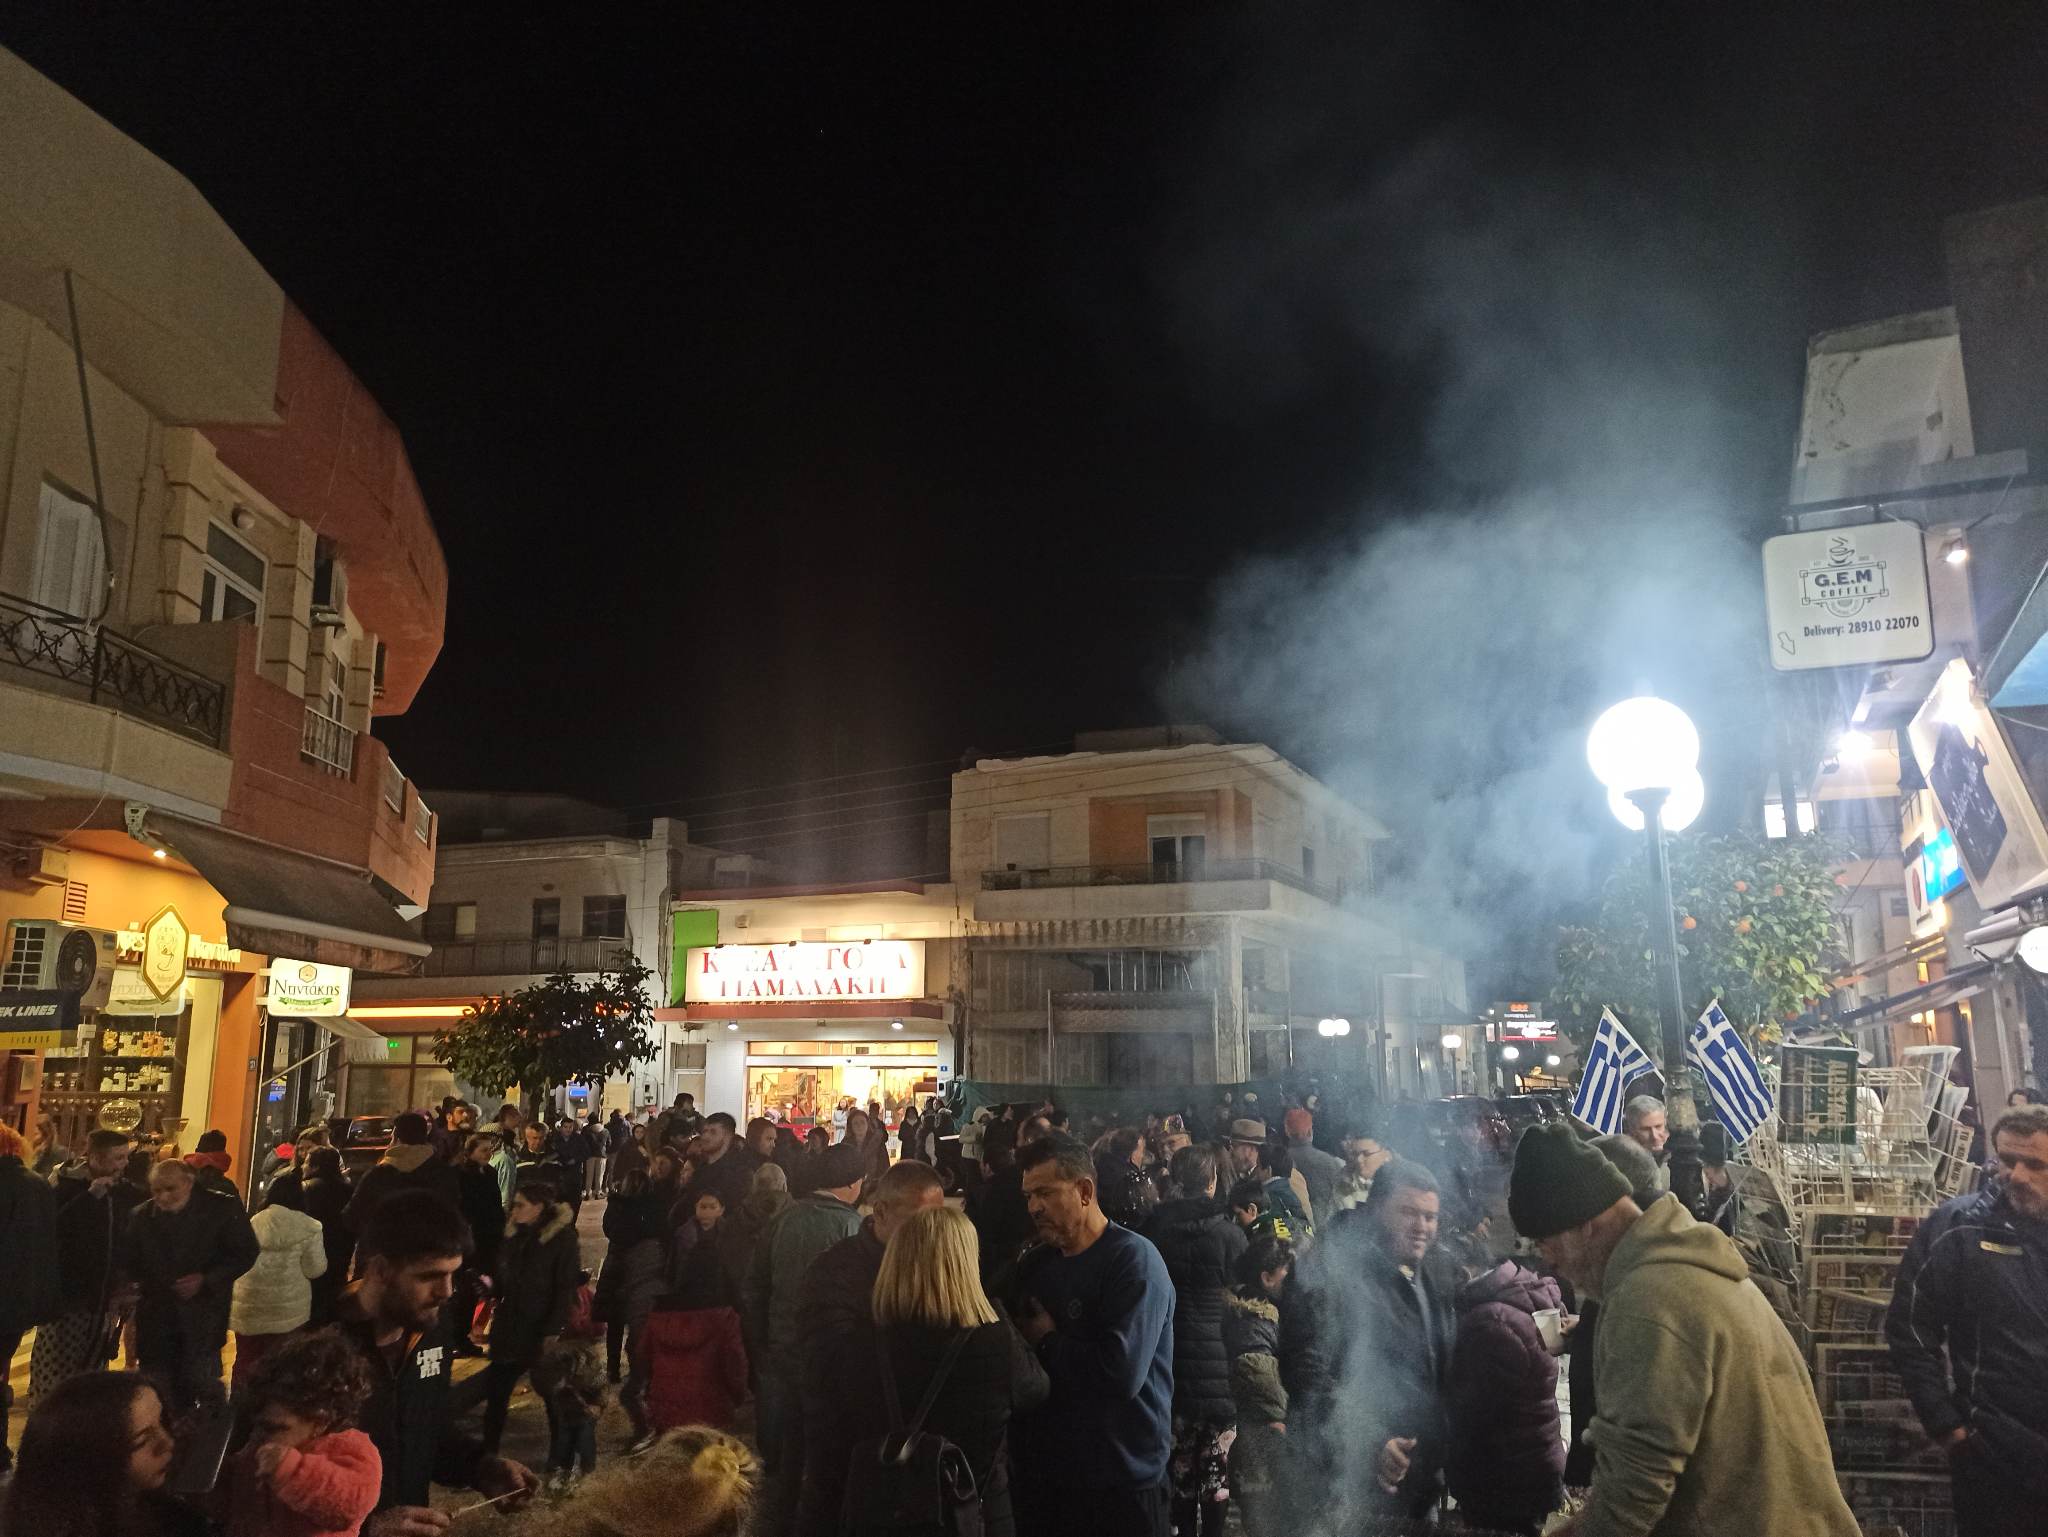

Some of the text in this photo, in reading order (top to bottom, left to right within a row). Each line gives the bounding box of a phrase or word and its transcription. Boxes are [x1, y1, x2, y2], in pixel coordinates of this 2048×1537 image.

[1814, 569, 1872, 587] G.E.M
[1803, 616, 1920, 637] Delivery: 28910 22070
[16, 1004, 58, 1016] LINES
